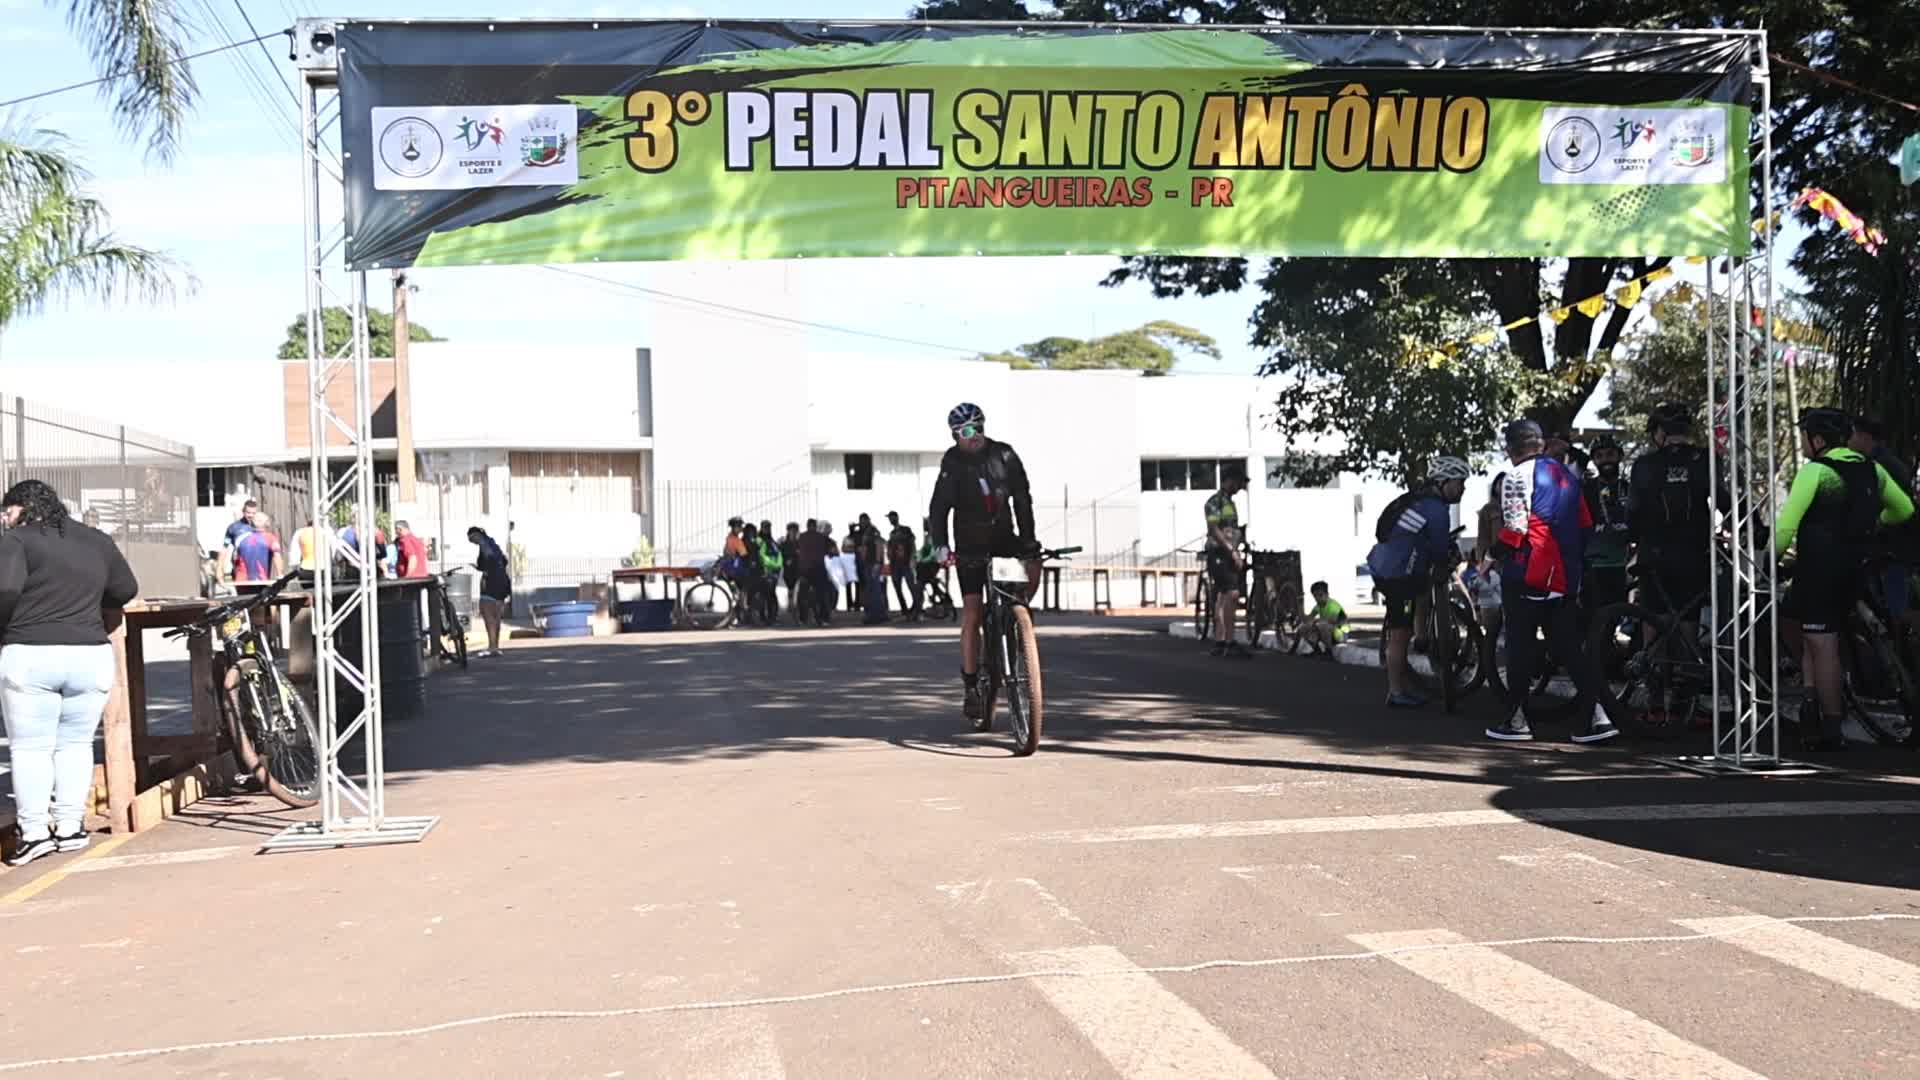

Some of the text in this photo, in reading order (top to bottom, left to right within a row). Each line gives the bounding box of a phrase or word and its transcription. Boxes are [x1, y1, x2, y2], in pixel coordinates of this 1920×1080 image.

[724, 88, 943, 171] PEDAL
[953, 89, 1184, 171] SANTO
[1189, 83, 1490, 173] ANTÔNIO
[896, 176, 1153, 208] PITANGUEIRAS
[1191, 176, 1234, 208] PR
